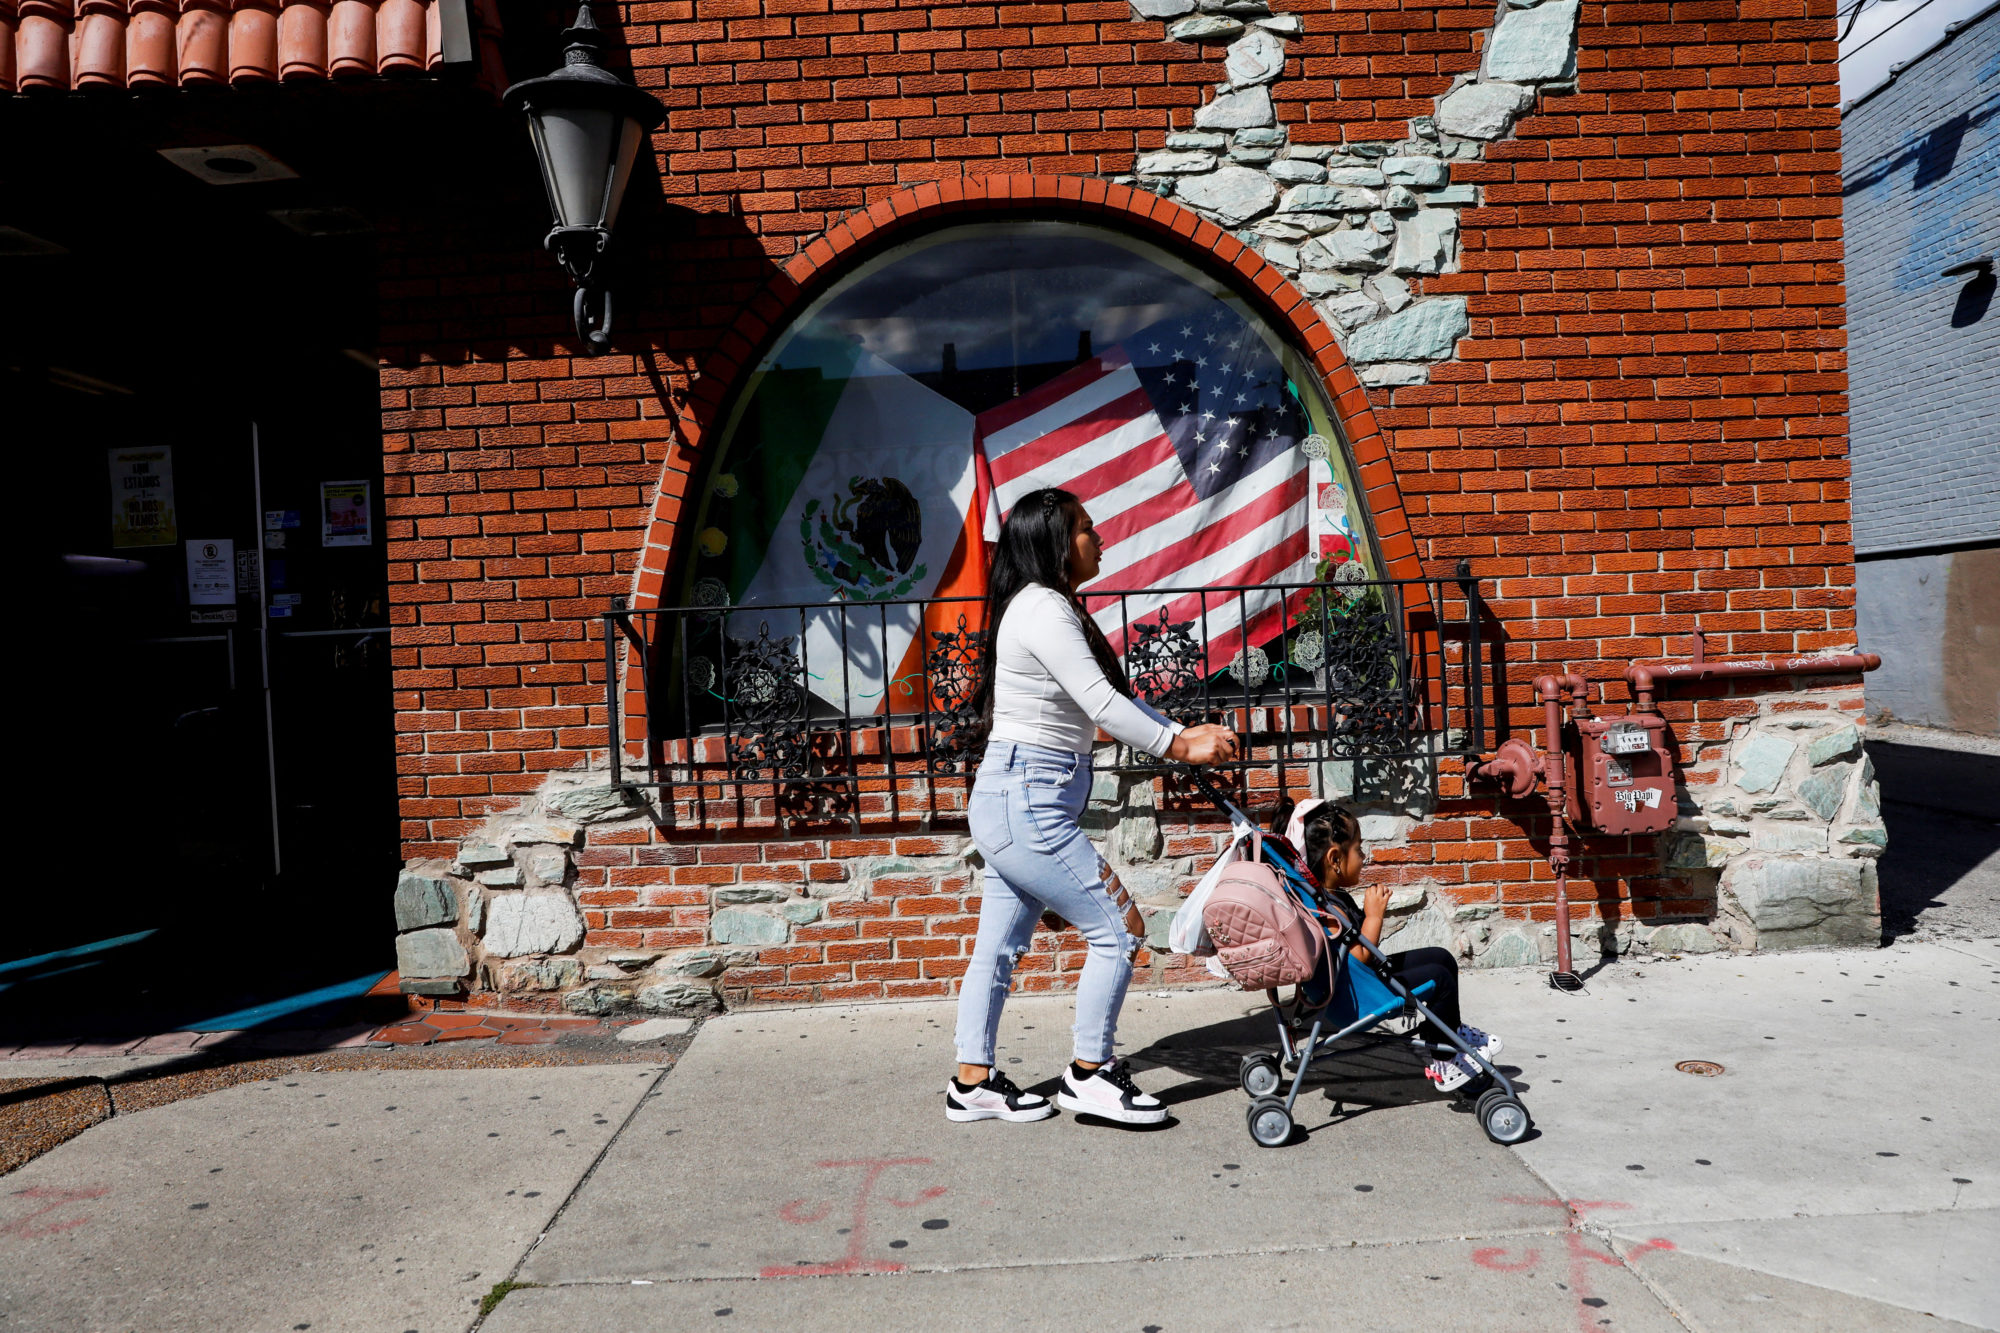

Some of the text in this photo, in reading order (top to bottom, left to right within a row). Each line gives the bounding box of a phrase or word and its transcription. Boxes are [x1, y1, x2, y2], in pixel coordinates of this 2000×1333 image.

[124, 476, 160, 488] ESTAMOS
[129, 514, 159, 526] VAMOS
[1616, 791, 1653, 802] Big Papi
